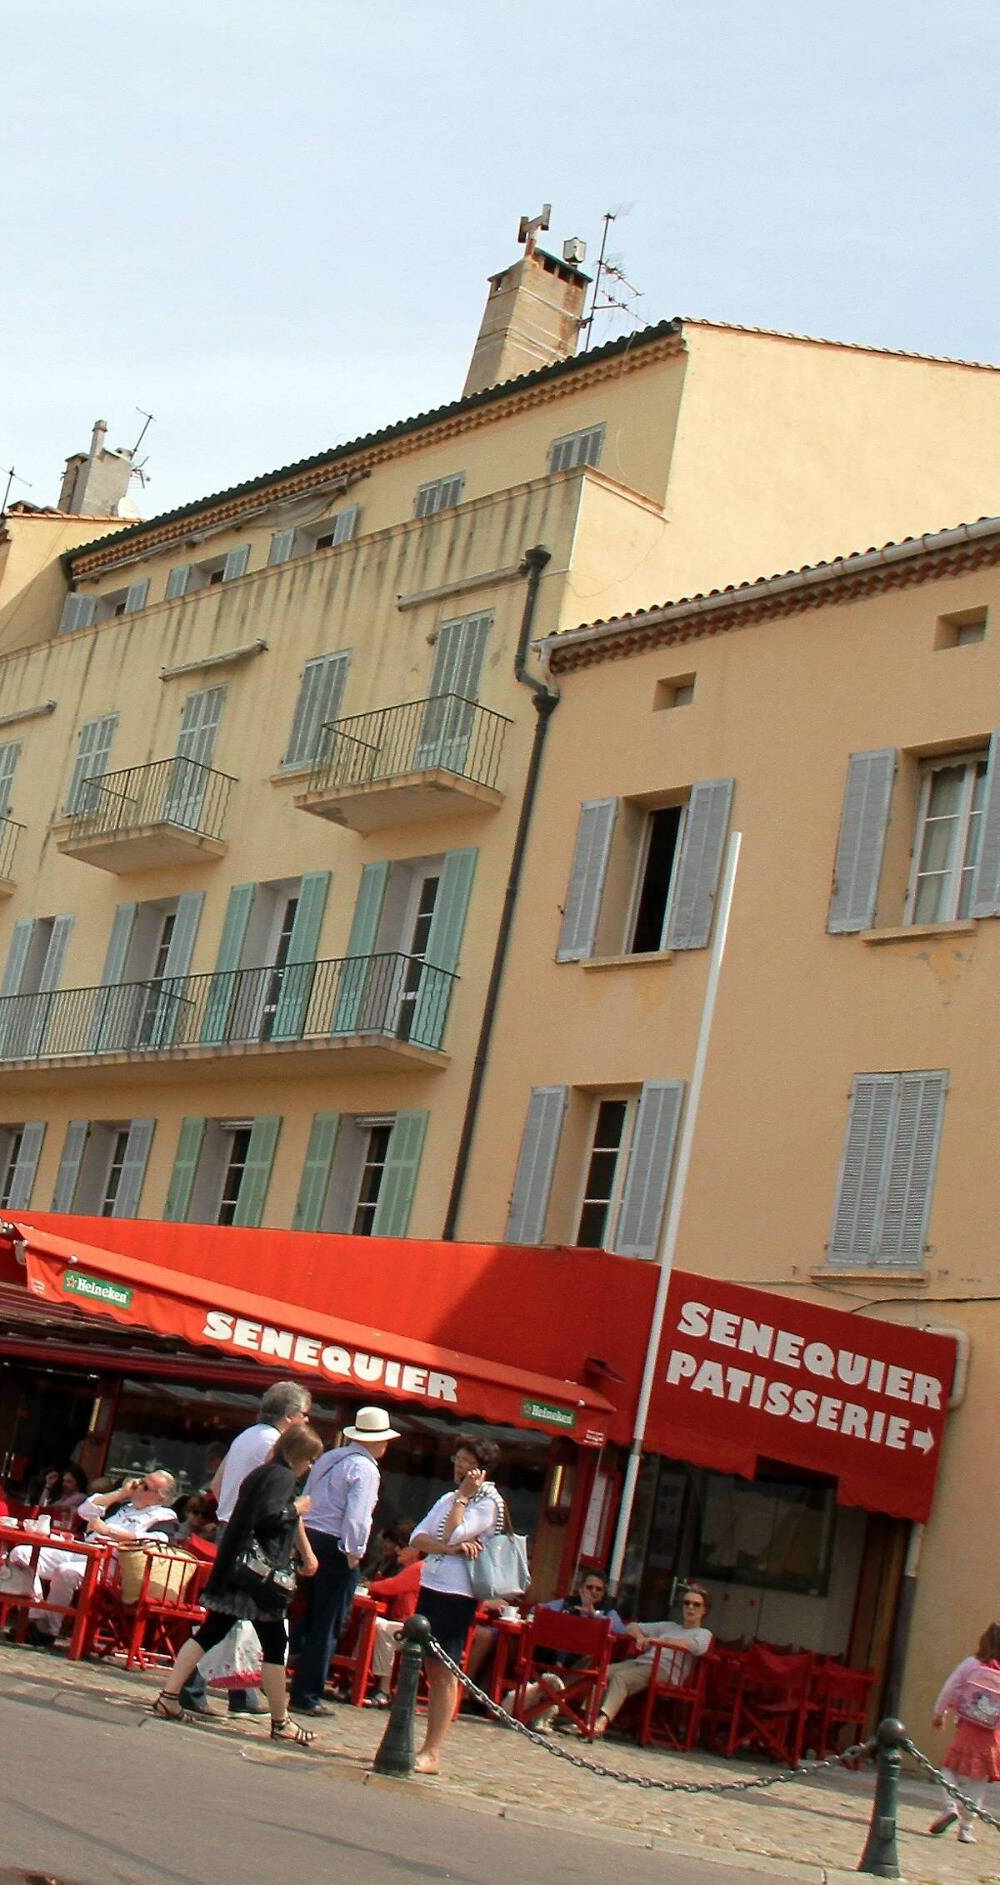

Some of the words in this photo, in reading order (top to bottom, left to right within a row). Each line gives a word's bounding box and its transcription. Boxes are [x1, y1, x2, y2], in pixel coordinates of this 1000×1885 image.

[77, 1278, 128, 1304] Heineken
[202, 1310, 459, 1403] SENEQUIER
[666, 1350, 910, 1450] PATISSERIE
[676, 1301, 942, 1410] SENEQUIER
